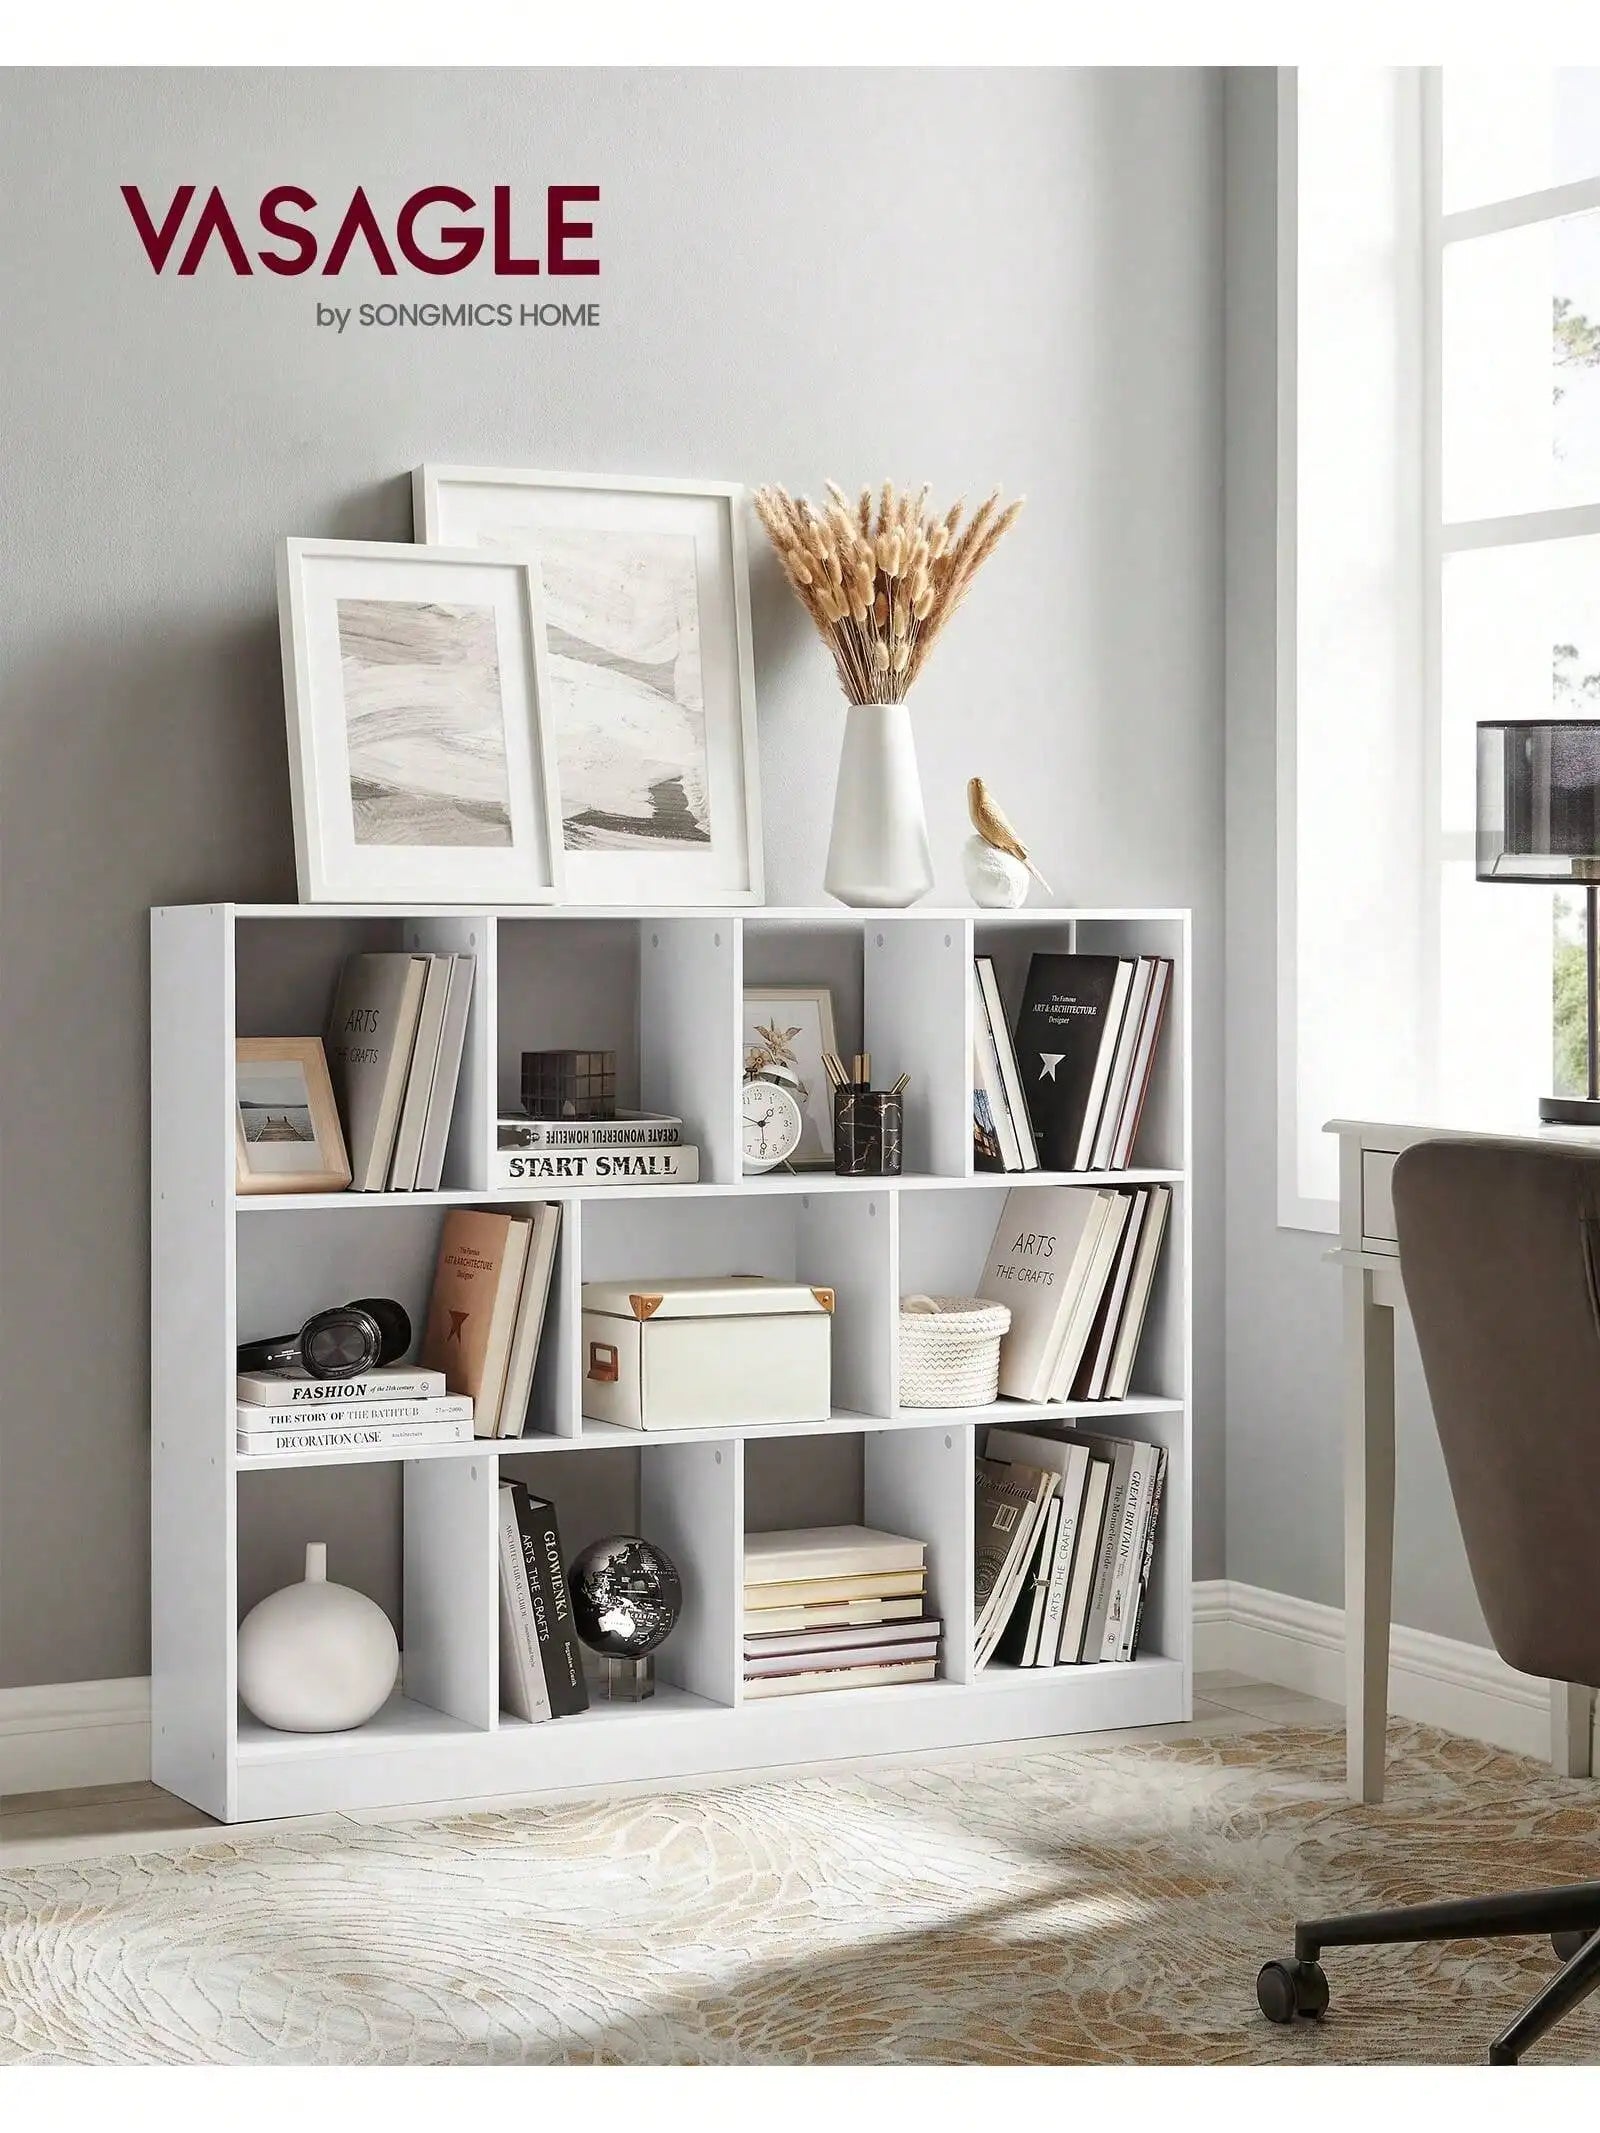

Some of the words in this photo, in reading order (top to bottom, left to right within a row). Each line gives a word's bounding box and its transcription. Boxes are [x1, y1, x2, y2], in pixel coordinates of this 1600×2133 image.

[344, 1008, 380, 1033] ARTS
[648, 1127, 679, 1143] CREATE
[783, 1119, 789, 1128] 3
[546, 1130, 589, 1145] HOMELIFE
[592, 1128, 646, 1144] WONDERFUL
[508, 1156, 588, 1178] START
[595, 1155, 679, 1177] SMALL
[1011, 1232, 1057, 1258] ARTS
[996, 1263, 1015, 1280] THE
[1017, 1267, 1055, 1286] CRAFTS
[291, 1383, 368, 1400] FASHION
[269, 1413, 292, 1425] THE
[294, 1412, 328, 1424] STORY
[330, 1411, 345, 1422] OF
[347, 1410, 369, 1421] THE
[371, 1407, 420, 1419] BATHTUB
[276, 1432, 352, 1449] DECORATION
[353, 1431, 382, 1444] CASE
[1113, 1484, 1124, 1502] The
[1127, 1470, 1142, 1509] GREAT
[1108, 1502, 1121, 1541] Monocle
[1060, 1518, 1074, 1560] CRAFTS
[1120, 1510, 1135, 1558] BRITAIN
[522, 1533, 536, 1564] ARTS
[1104, 1542, 1114, 1569] Guide
[528, 1567, 541, 1593] THE
[1054, 1565, 1066, 1587] THE
[1049, 1591, 1061, 1620] ARTS
[533, 1597, 550, 1642] CRAFTS
